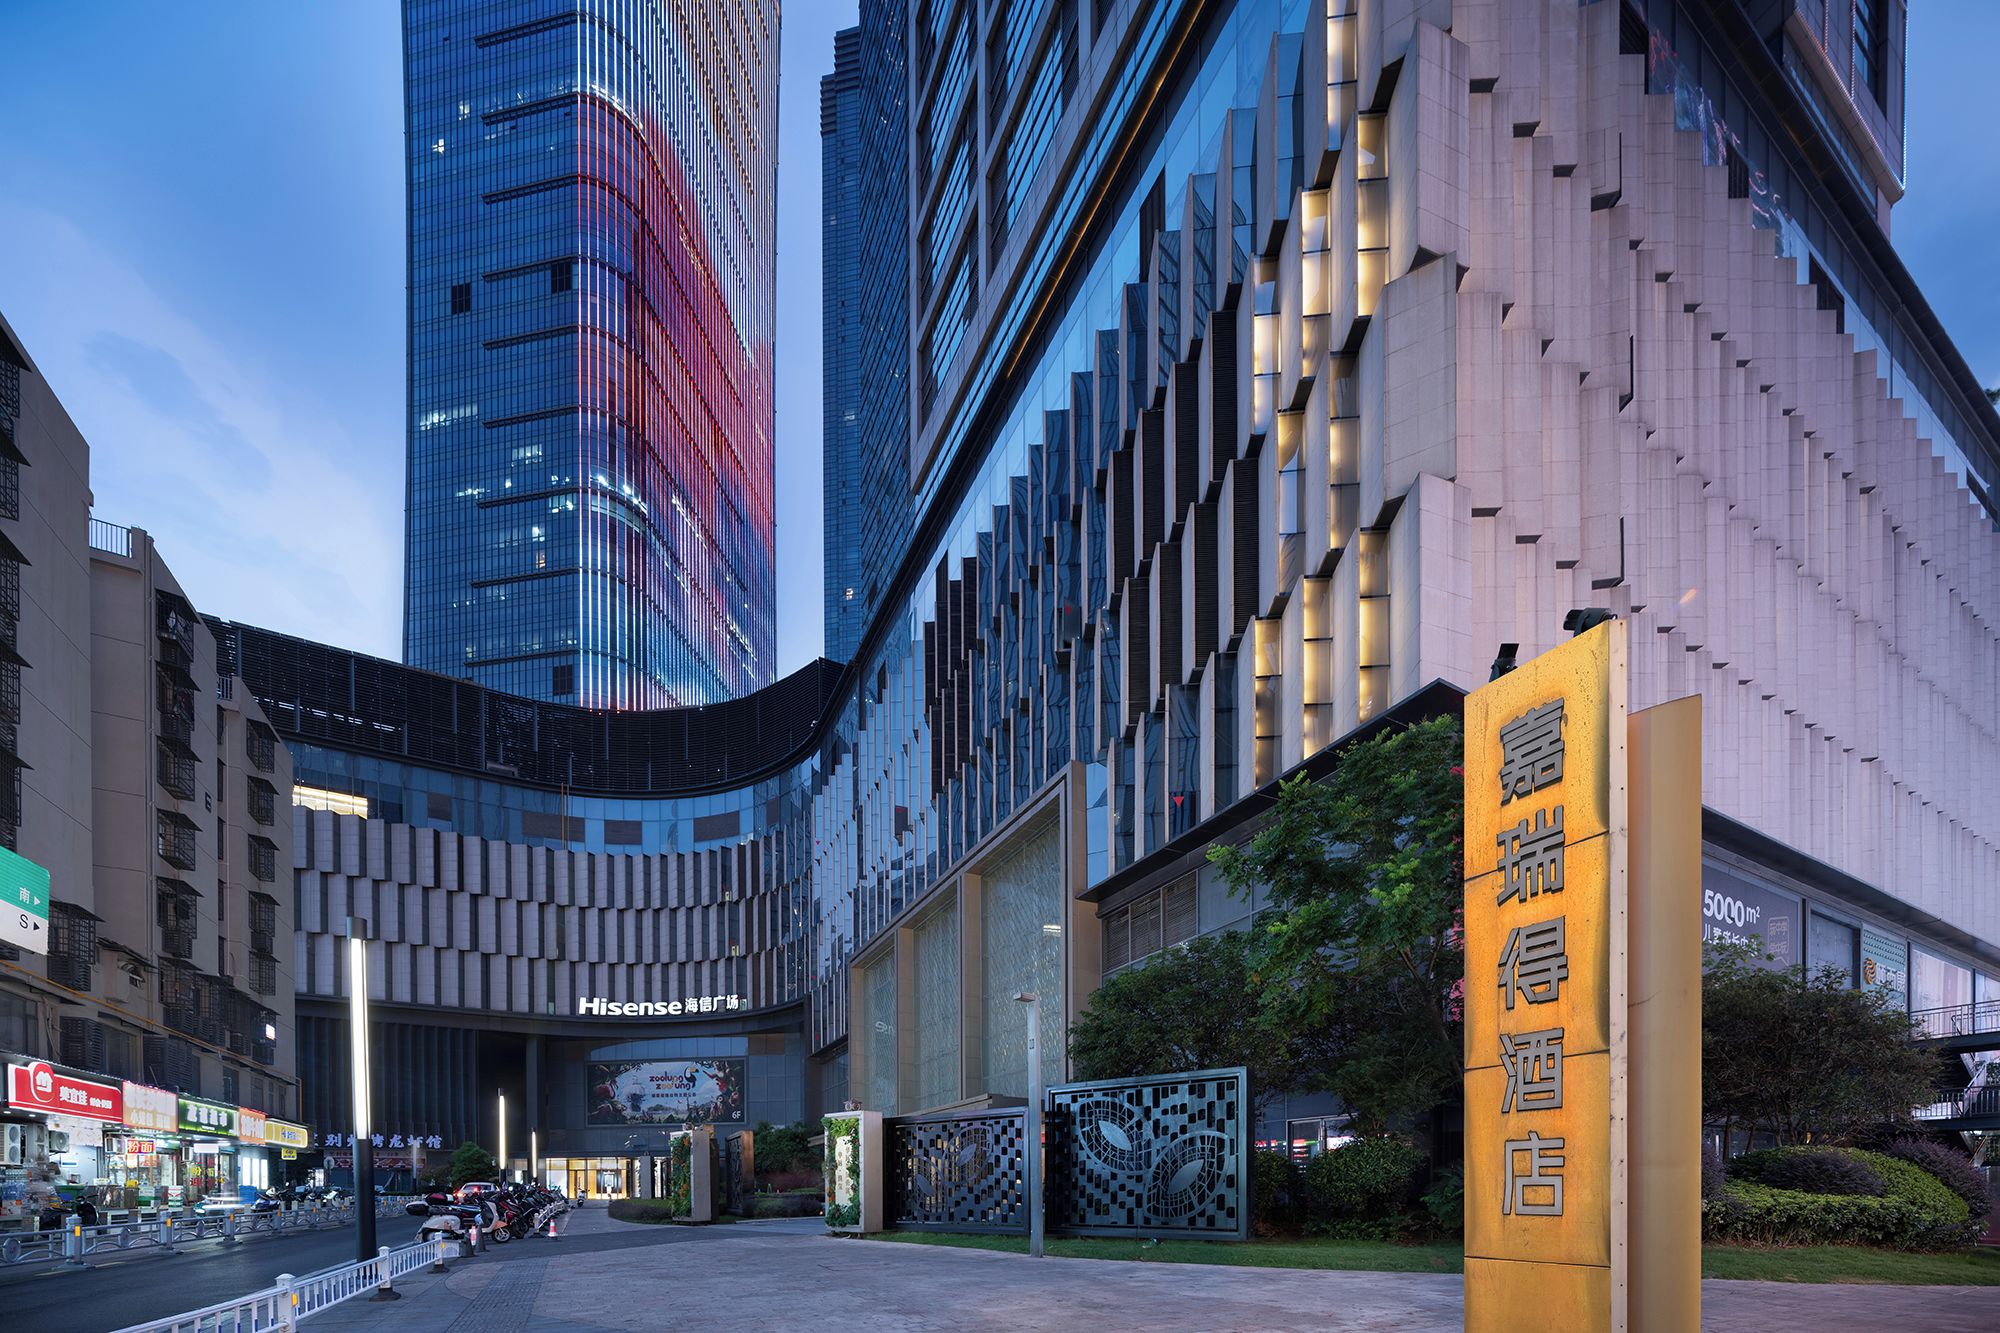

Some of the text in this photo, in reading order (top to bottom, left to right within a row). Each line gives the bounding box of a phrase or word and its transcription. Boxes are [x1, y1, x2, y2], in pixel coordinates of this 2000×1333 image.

[19, 887, 31, 904] 南
[19, 914, 29, 929] S
[1497, 698, 1569, 1218] 嘉瑞得酒店
[579, 994, 739, 1016] Hisense 海信广场
[731, 1110, 742, 1120] 6F
[128, 1140, 153, 1153] 粉面
